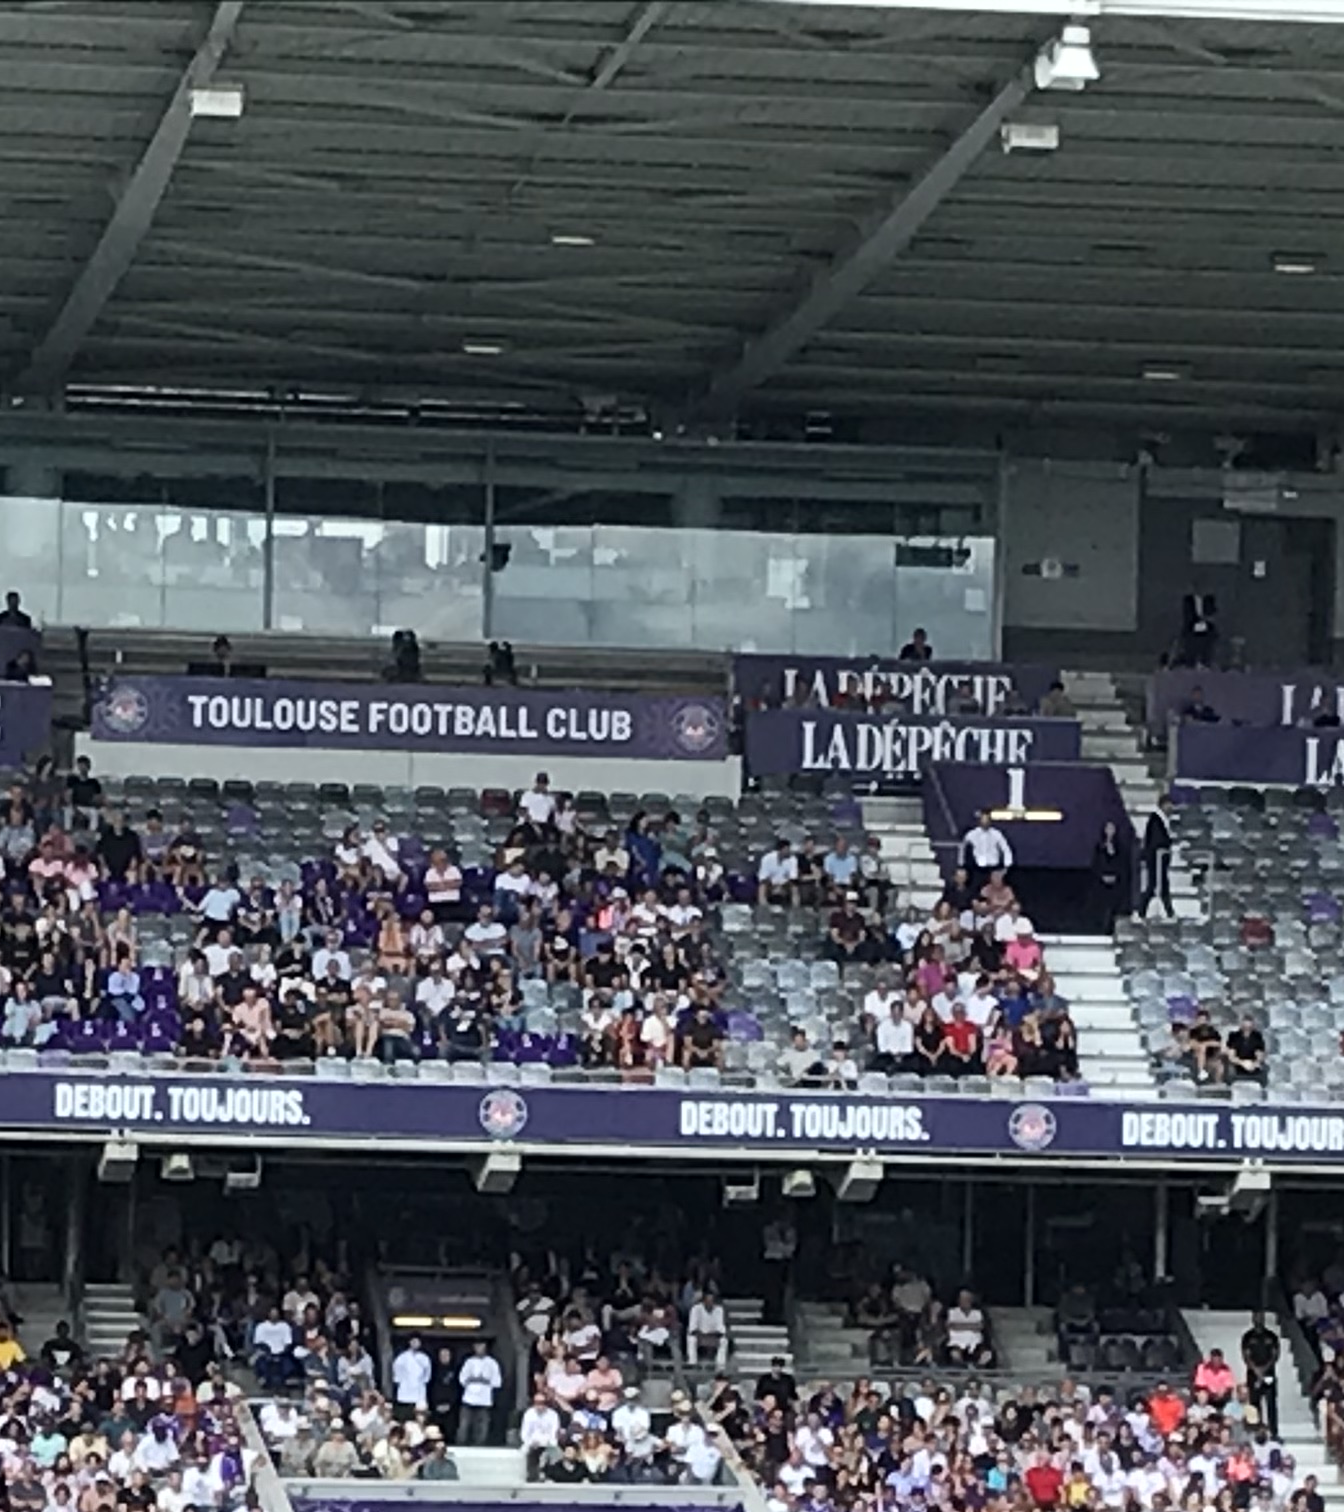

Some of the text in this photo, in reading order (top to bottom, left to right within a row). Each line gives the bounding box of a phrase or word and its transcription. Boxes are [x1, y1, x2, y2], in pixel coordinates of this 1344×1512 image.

[188, 695, 632, 741] TOULOUSE FOOTBALL CLUB
[802, 719, 1033, 771] LA DÉPÊCHE
[1006, 767, 1026, 814] 1
[56, 1083, 311, 1124] DEBOUT. TOUJOURS.
[681, 1101, 929, 1140] DEBOUT. TOUJOURS.
[1122, 1112, 1226, 1148] DEBOUT.
